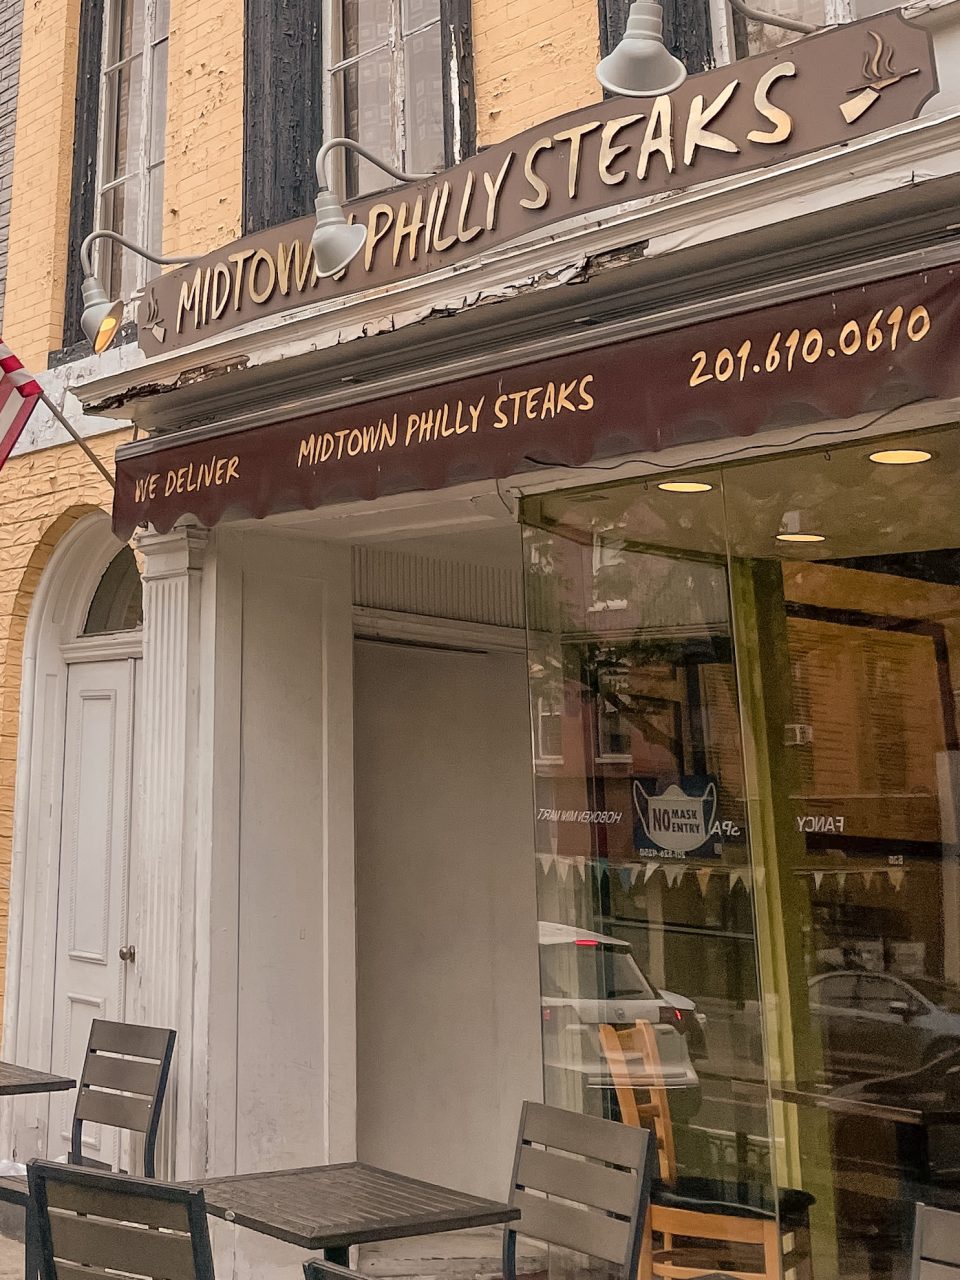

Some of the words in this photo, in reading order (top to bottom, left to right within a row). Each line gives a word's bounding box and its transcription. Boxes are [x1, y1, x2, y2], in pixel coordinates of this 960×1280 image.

[364, 151, 516, 273] PHILLY
[519, 61, 797, 210] STEAKS
[689, 304, 932, 388] 201.610.0610
[296, 413, 399, 468] MIDTOWN
[404, 396, 486, 448] PHILLY
[493, 374, 596, 430] STEAKS
[134, 472, 158, 503] WE
[164, 455, 240, 498] DELIVER
[653, 808, 671, 832] NO
[671, 809, 697, 820] MASK
[672, 823, 700, 834] ENTRY
